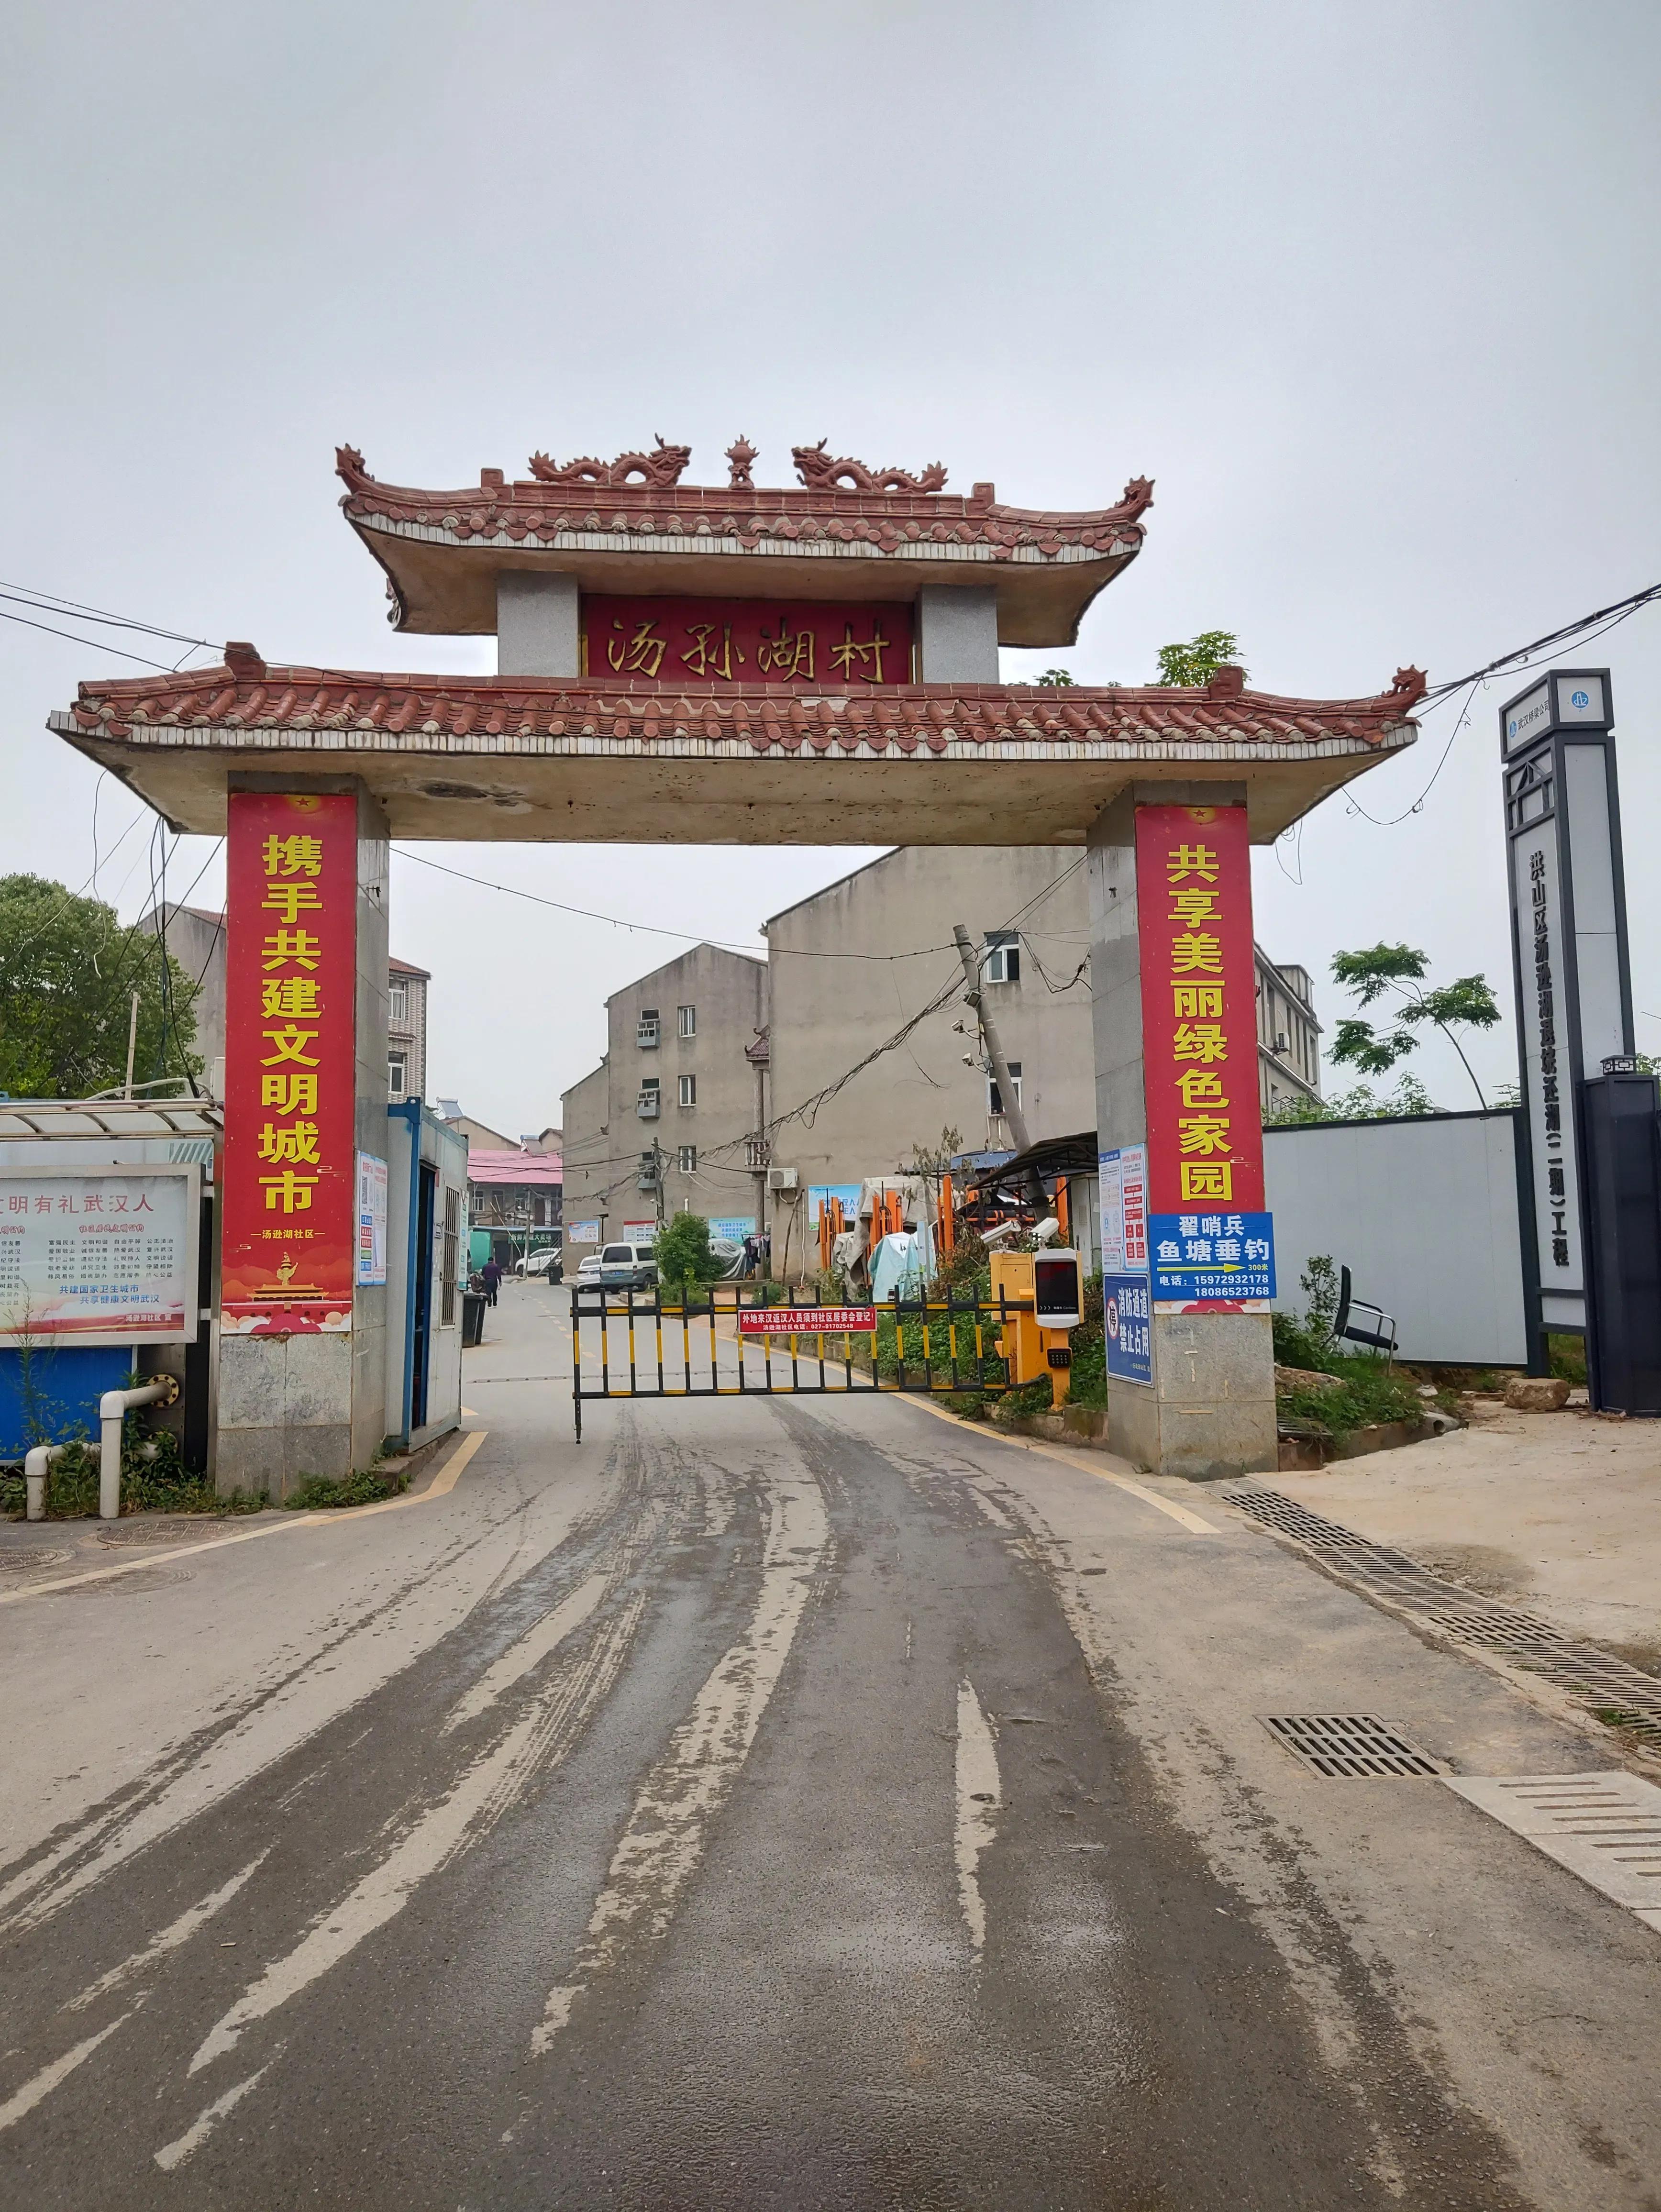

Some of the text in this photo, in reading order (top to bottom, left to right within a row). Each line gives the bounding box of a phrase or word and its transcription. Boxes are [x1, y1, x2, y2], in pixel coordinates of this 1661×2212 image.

[607, 616, 891, 685] 汤孙湖村
[1517, 699, 1550, 730] 武汉桥梁公司
[257, 834, 322, 1214] 携手共建文明城市
[1166, 844, 1233, 1201] 共享美丽绿色家园
[0, 1194, 154, 1214] 明有礼武汉人
[0, 1225, 26, 1235] 明公约
[1179, 1215, 1244, 1238] 翟哨兵
[1156, 1239, 1270, 1262] 鱼塘垂钓
[59, 1284, 139, 1294] 共建国家卫生城市
[80, 1294, 159, 1305] 共享健康文明武汉
[1195, 1286, 1269, 1297] 18086523768
[1118, 1287, 1148, 1319] 消防通道
[1119, 1323, 1149, 1357] 禁止占用
